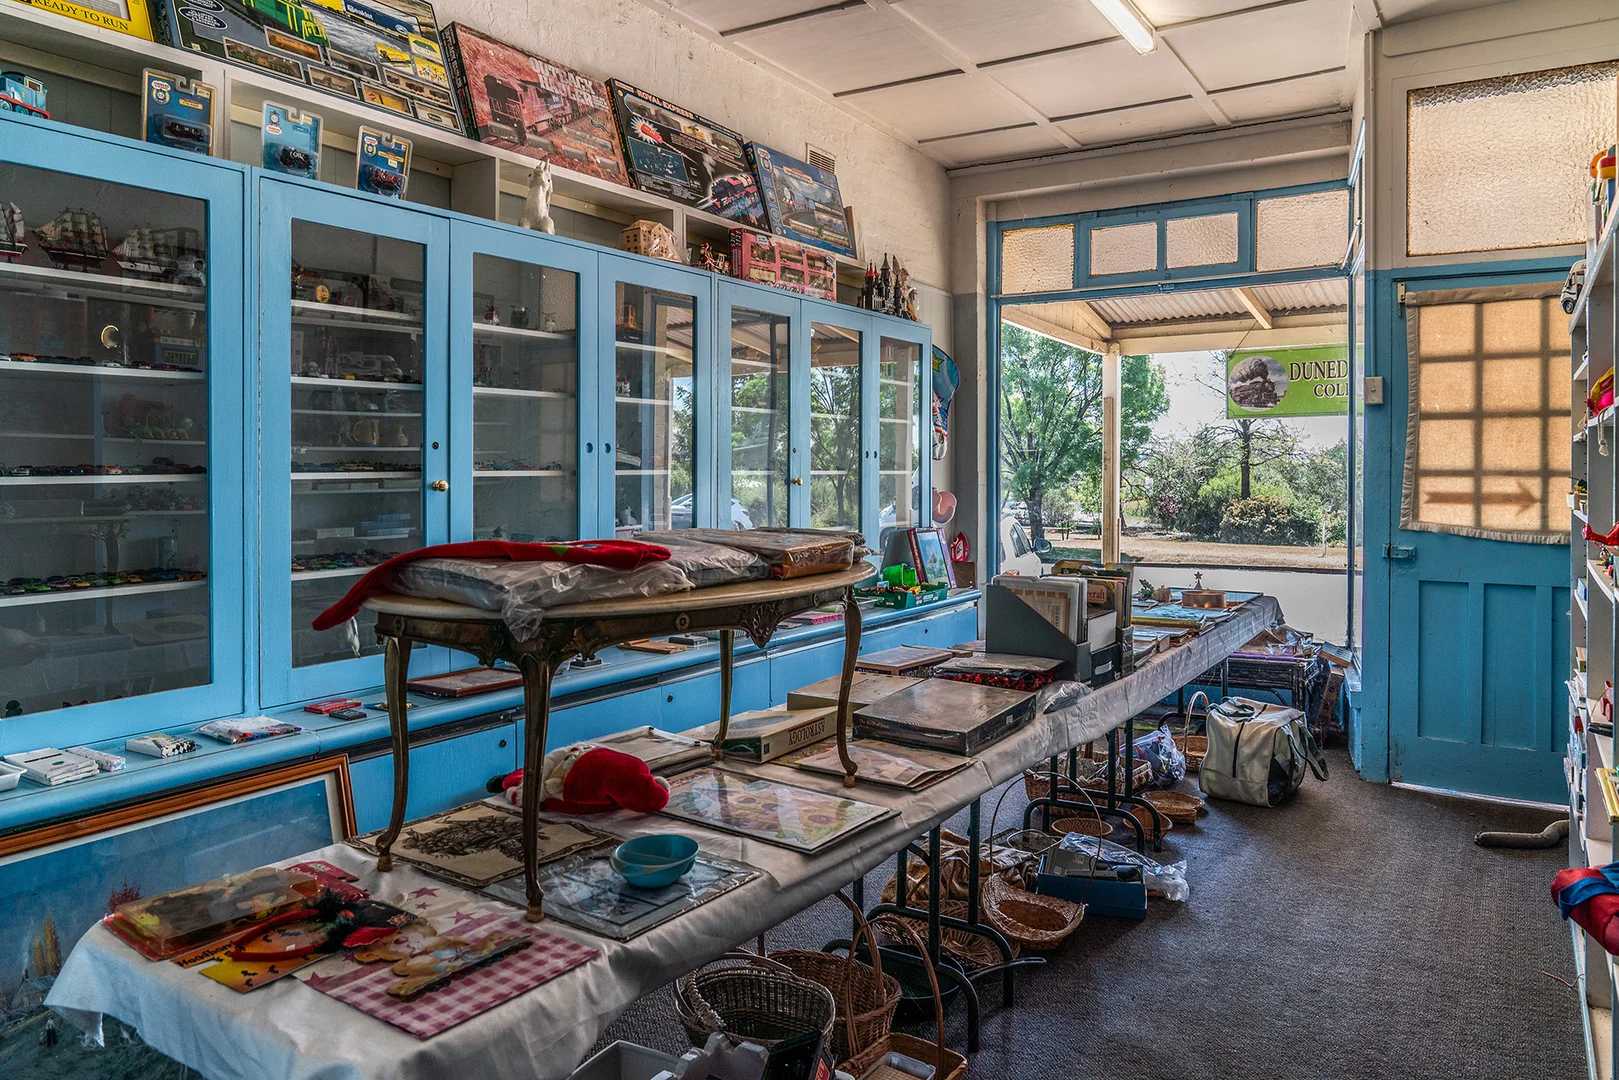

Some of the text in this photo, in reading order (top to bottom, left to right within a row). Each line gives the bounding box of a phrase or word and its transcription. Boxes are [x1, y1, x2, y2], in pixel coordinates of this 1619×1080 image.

[81, 10, 100, 22] TO
[102, 16, 129, 31] RUN
[529, 56, 596, 95] OUTBACK
[537, 73, 595, 108] HAULER
[636, 89, 694, 120] ROYAL EXPRESS
[1289, 360, 1348, 381] DUNED
[788, 721, 826, 746] ASTROLOGY
